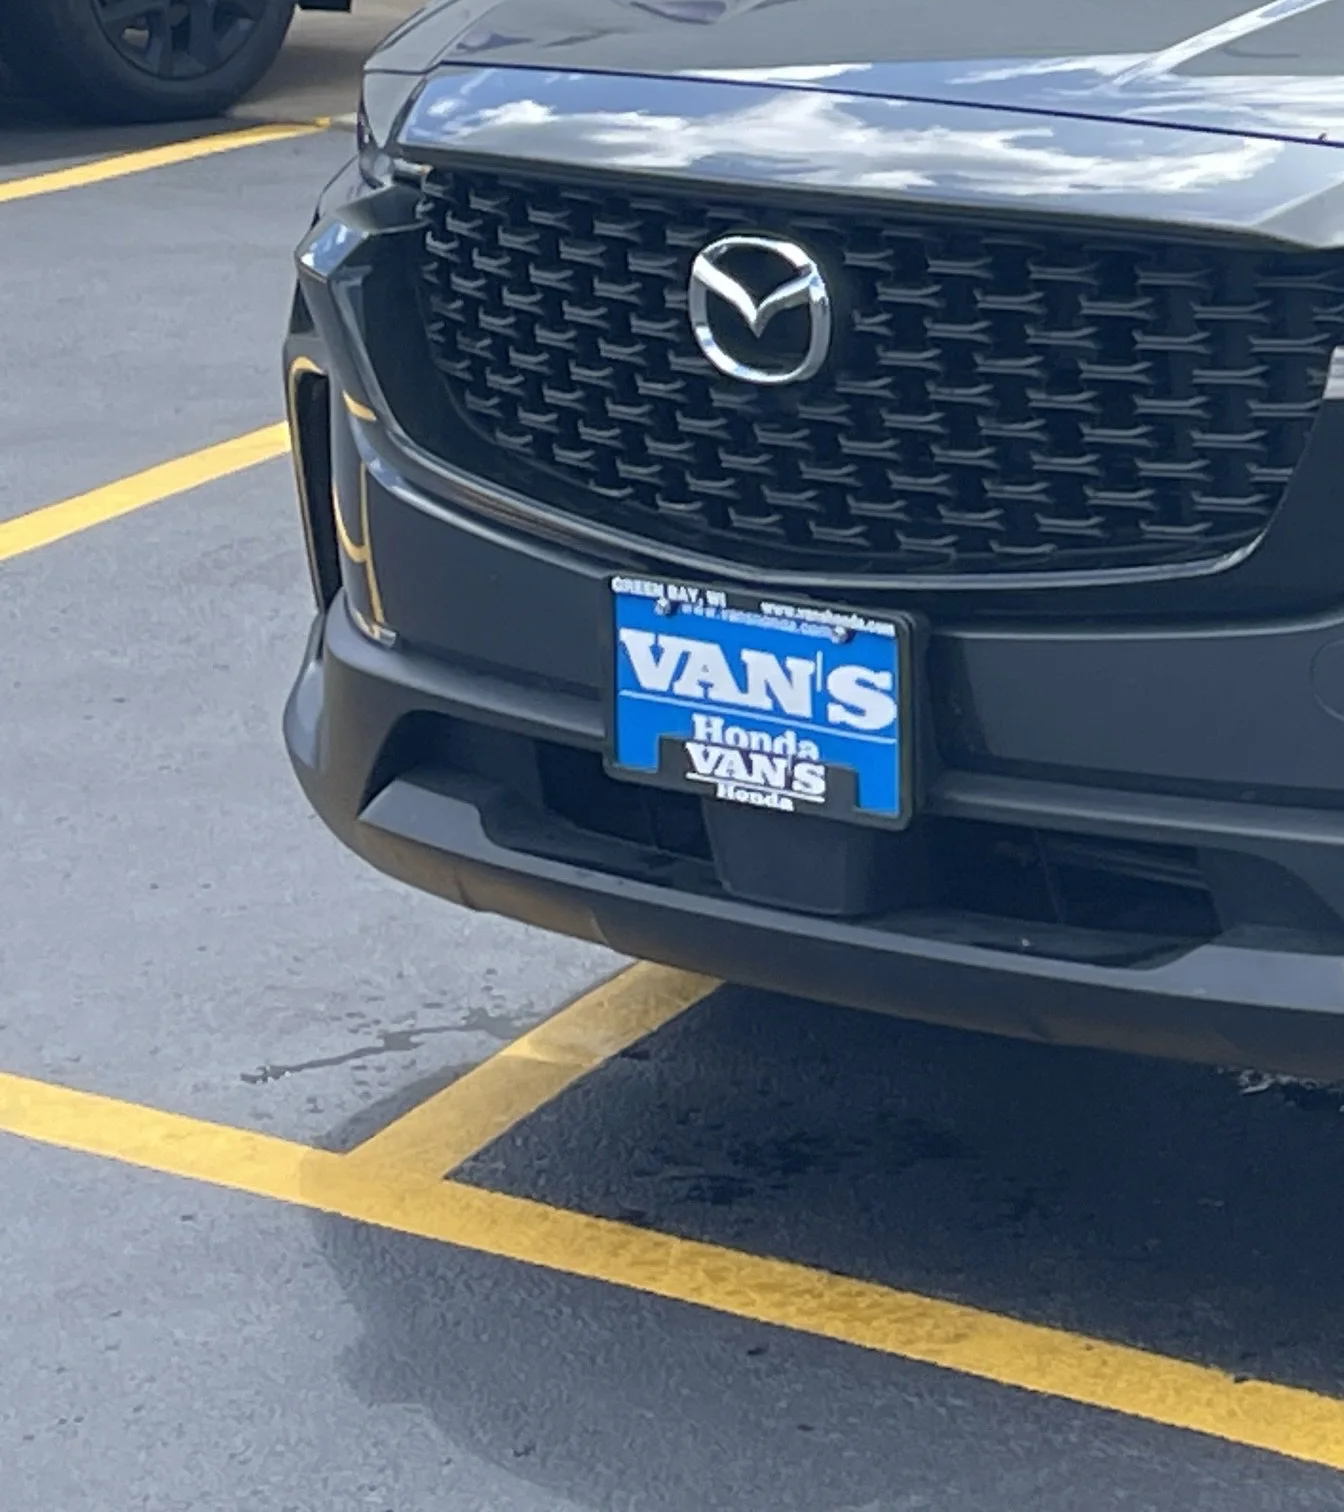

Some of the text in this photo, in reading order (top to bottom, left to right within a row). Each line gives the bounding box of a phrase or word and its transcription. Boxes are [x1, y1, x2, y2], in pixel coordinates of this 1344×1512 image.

[611, 575, 664, 599] GREEN
[706, 589, 727, 609] WI
[619, 627, 899, 731] VAN'S
[691, 713, 820, 762] Honda
[685, 741, 827, 795] VAN'S
[715, 781, 795, 812] Honda
